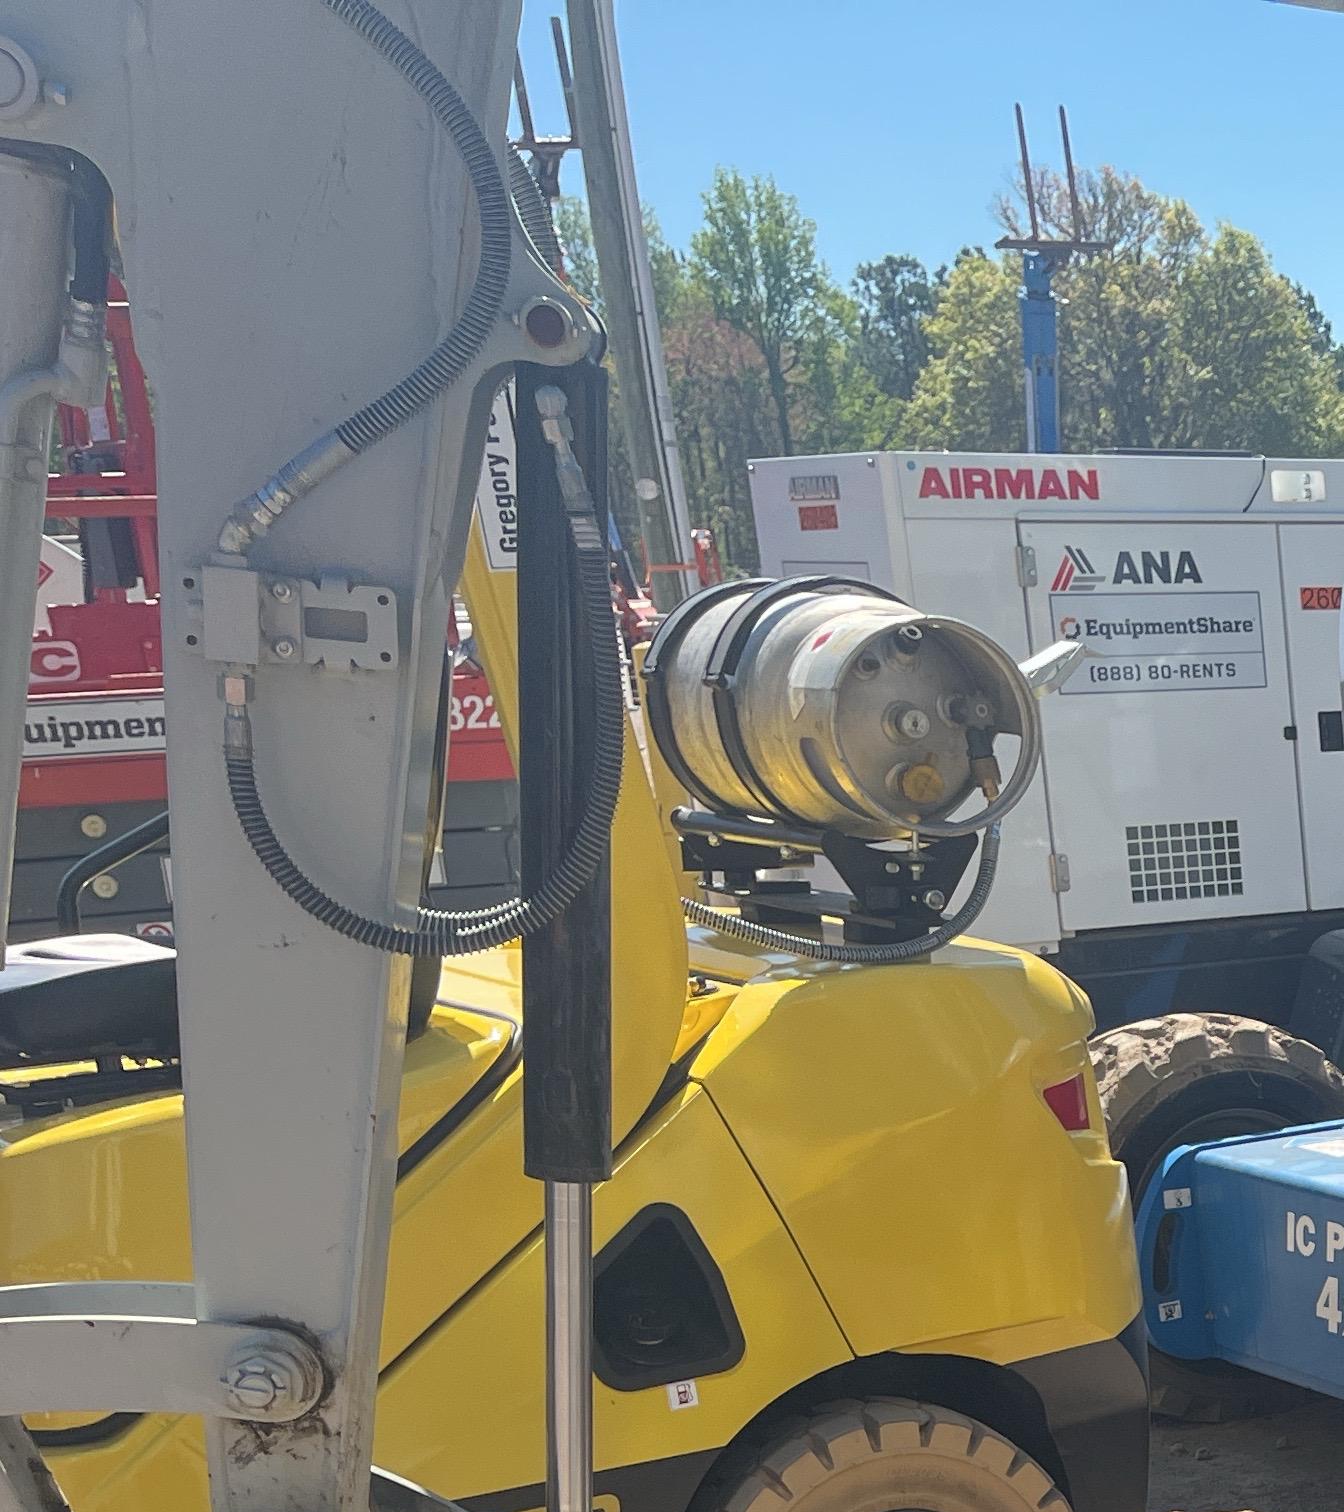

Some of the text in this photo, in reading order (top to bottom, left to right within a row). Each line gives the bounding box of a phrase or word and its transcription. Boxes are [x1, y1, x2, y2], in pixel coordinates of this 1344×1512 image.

[919, 467, 1101, 500] AIRMAN
[486, 453, 518, 553] Gregory
[1112, 550, 1203, 584] ANA
[1302, 587, 1342, 609] 260
[1085, 616, 1253, 639] EquipmentShare
[1089, 662, 1236, 682] (888) 80-RENTS
[25, 716, 166, 748] uipmen
[1286, 1211, 1316, 1257] IC
